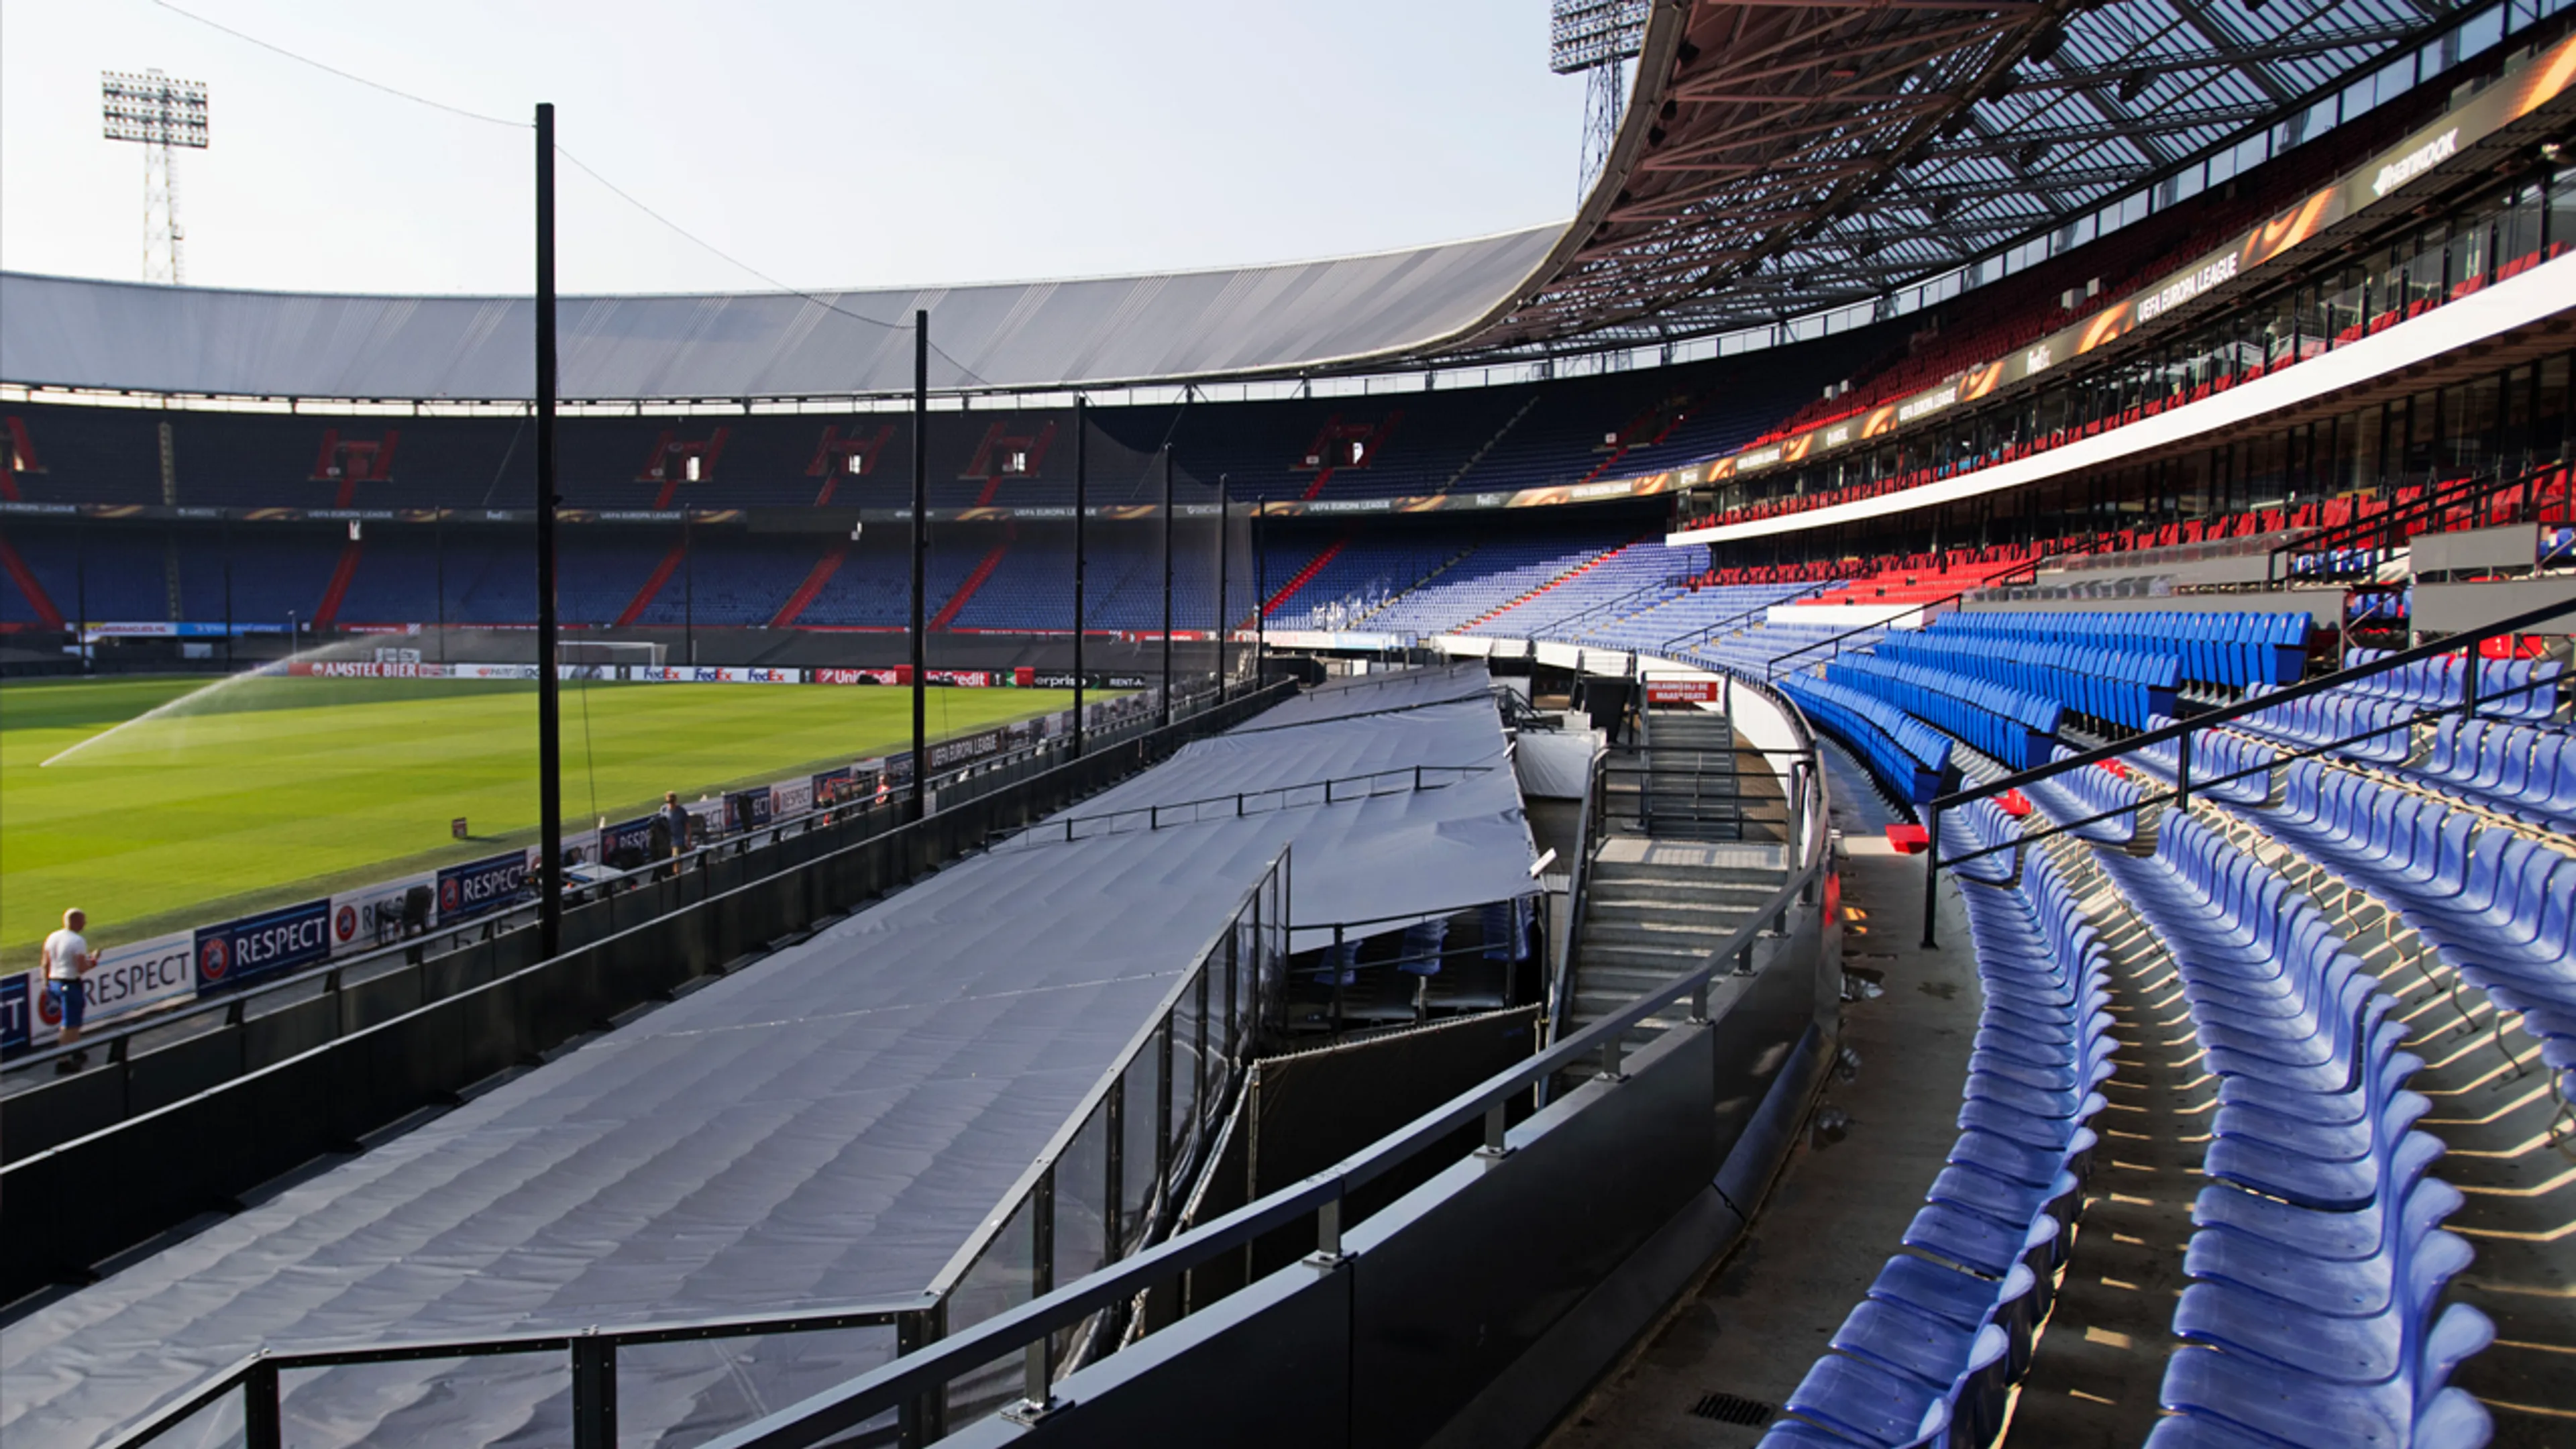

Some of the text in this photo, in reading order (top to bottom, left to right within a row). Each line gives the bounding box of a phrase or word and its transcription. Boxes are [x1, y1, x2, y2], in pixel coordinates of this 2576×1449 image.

[2138, 251, 2239, 323] UEFA EUROPA LEAGUE
[1360, 499, 1390, 509] LEAGUE
[1014, 508, 1035, 517] UEFA
[1036, 508, 1065, 517] EUROPA
[325, 662, 381, 678] AMSTEL
[382, 663, 419, 678] BIER
[643, 666, 680, 680] FedEx
[694, 667, 733, 682] FedEx
[747, 667, 784, 682] FedEx
[932, 747, 949, 767] UEFA
[949, 739, 973, 762] EUROPA
[974, 733, 997, 755] LEAGUE
[463, 864, 525, 902] RESPECT
[236, 916, 326, 967] RESPECT
[82, 951, 191, 1006] RESPECT
